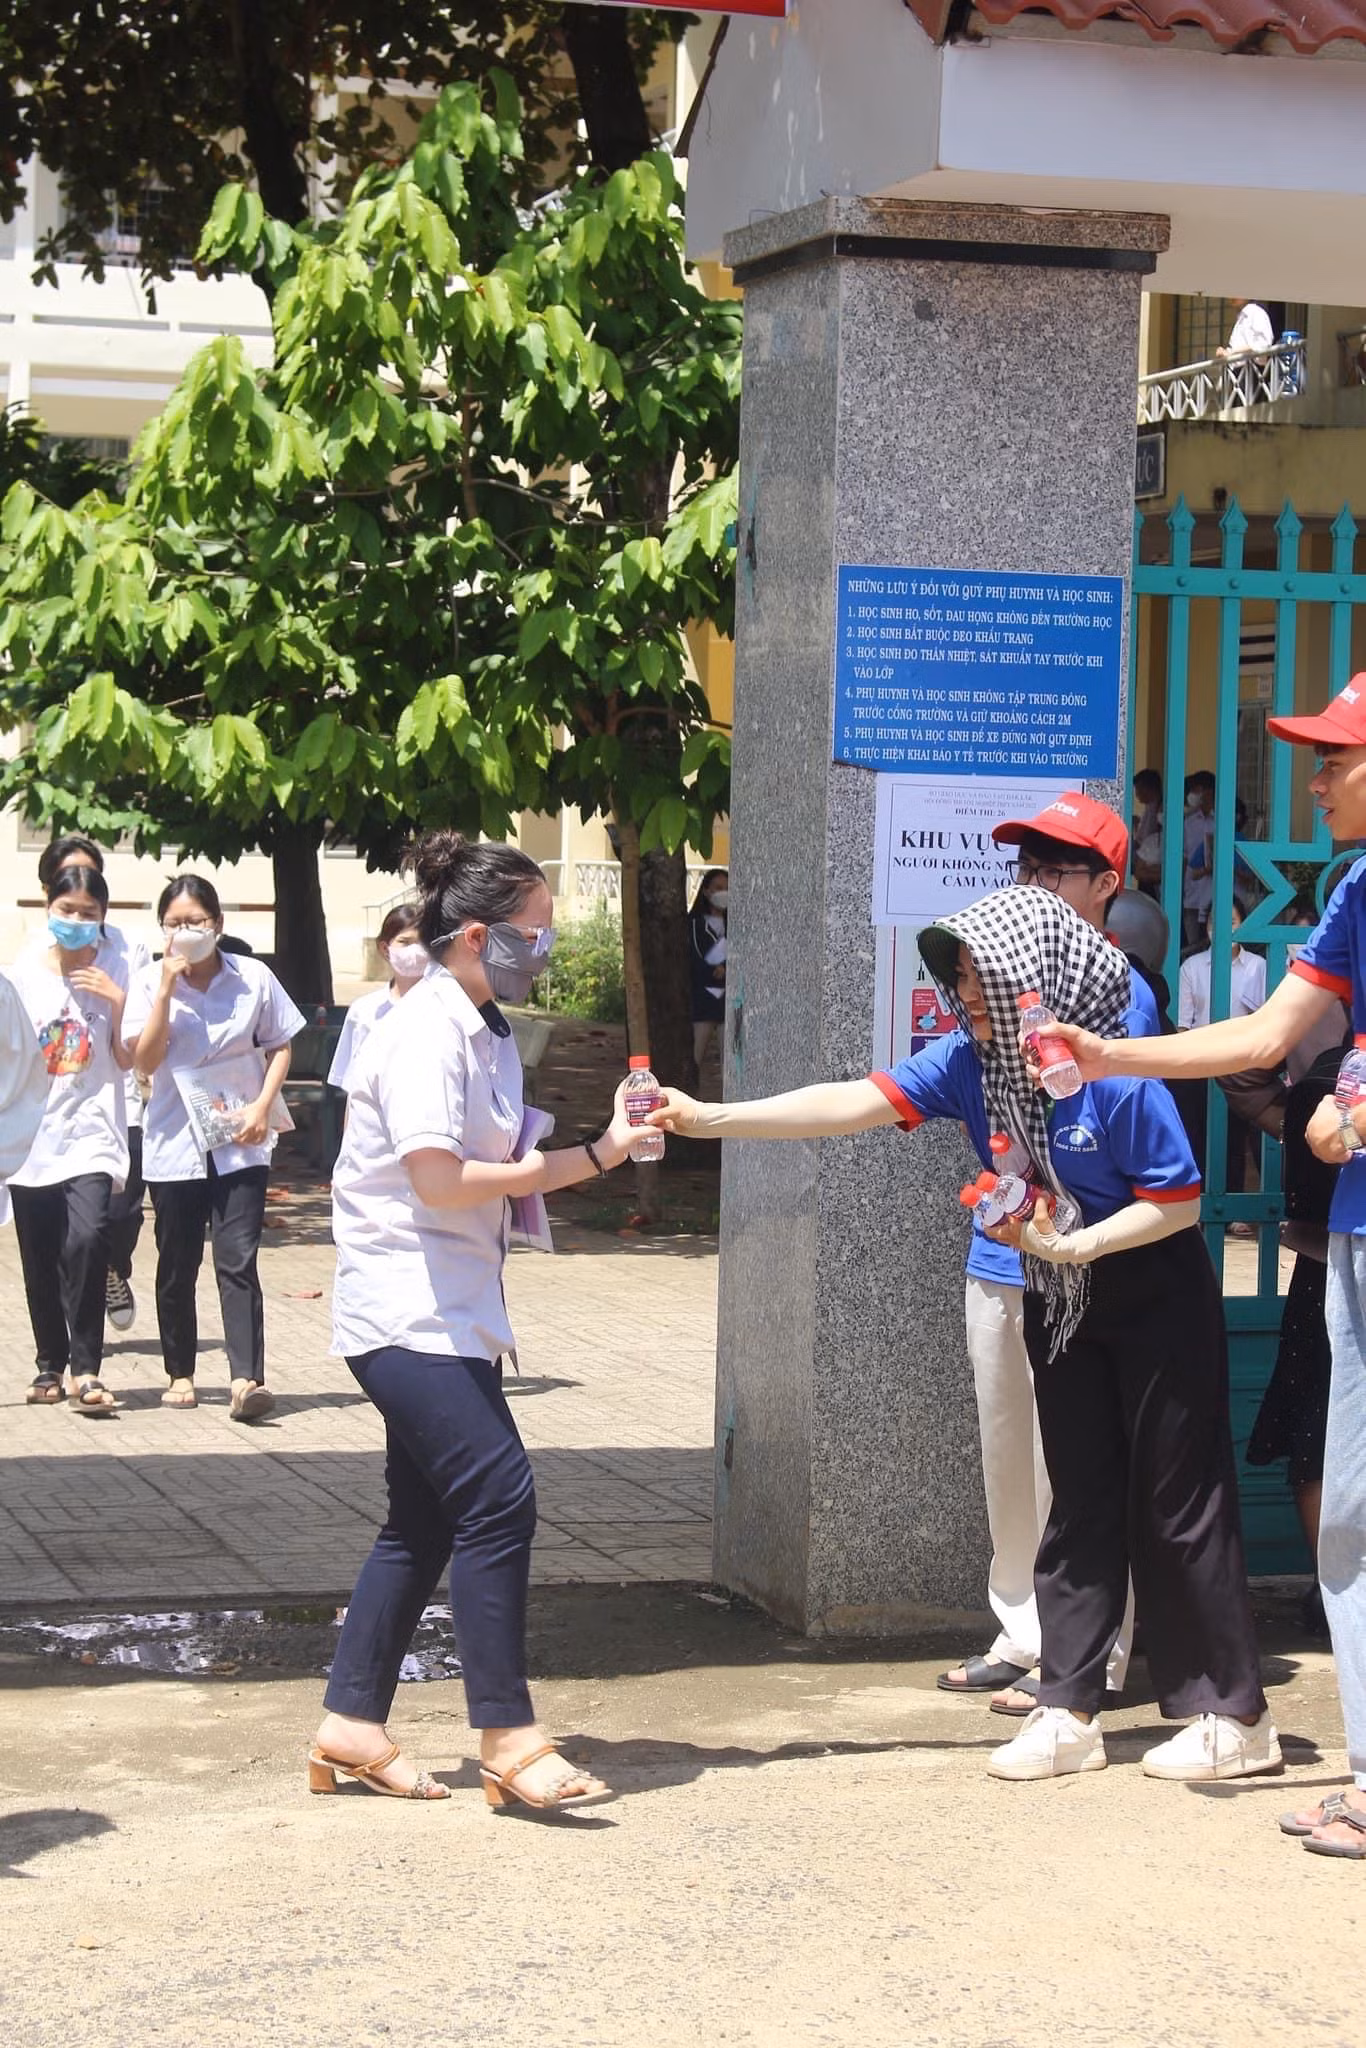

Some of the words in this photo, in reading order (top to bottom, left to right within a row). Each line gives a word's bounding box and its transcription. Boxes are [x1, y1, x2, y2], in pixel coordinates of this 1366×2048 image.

[848, 577, 884, 592] NHỮNG
[887, 580, 908, 594] LƯU
[911, 579, 918, 594] Ý
[920, 578, 938, 596] ĐỐI
[942, 580, 959, 596] VỚI
[962, 582, 983, 600] QUÝ
[986, 586, 1006, 602] PHỤ
[1009, 587, 1044, 600] HUYNH
[1047, 586, 1060, 601] VÀ
[1063, 590, 1083, 605] HỌC
[1087, 590, 1113, 603] SINH:
[848, 606, 856, 617] 1.
[858, 607, 878, 621] HỌC
[880, 608, 902, 619] SINH
[946, 610, 965, 622] ĐAU
[968, 611, 993, 626] HỌNG
[996, 610, 1028, 624] KHÔNG
[1031, 608, 1050, 625] ĐẾN
[1053, 612, 1090, 627] TRƯỜNG
[1093, 617, 1112, 631] HỌC
[846, 626, 855, 638] 2.
[858, 627, 878, 641] HỌC
[880, 628, 902, 639] SINH
[926, 627, 950, 644] BUỘC
[953, 630, 972, 642] ĐEO
[1003, 632, 1033, 645] TRANG
[846, 646, 854, 657] 3.
[857, 646, 877, 661] HỌC
[880, 648, 901, 659] SINH
[904, 648, 918, 660] ĐO
[920, 646, 945, 661] THÂN
[980, 648, 998, 663] SÁT
[1034, 653, 1051, 665] TAY
[1053, 651, 1084, 666] TRƯỚC
[1086, 656, 1103, 667] KHI
[854, 664, 873, 678] VÀO
[875, 664, 894, 679] LỚP
[845, 687, 853, 698] 4.
[856, 687, 875, 702] PHỤ
[878, 688, 909, 700] HUYNH
[912, 686, 924, 700] VÀ
[926, 690, 946, 704] HỌC
[948, 690, 970, 702] SINH
[973, 689, 1005, 704] KHÔNG
[1008, 690, 1025, 707] TẬP
[1028, 693, 1058, 705] TRUNG
[1061, 692, 1087, 706] ĐÔNG
[853, 704, 884, 719] TRƯỚC
[915, 706, 953, 721] TRƯỜNG
[956, 708, 968, 722] VÀ
[971, 708, 988, 722] GIỮ
[1031, 710, 1055, 725] CÁCH
[1058, 714, 1071, 726] 2M
[844, 727, 852, 738] 5.
[855, 728, 874, 742] PHỤ
[877, 728, 908, 740] HUYNH
[911, 726, 923, 740] VÀ
[926, 730, 944, 744] HỌC
[948, 730, 969, 742] SINH
[986, 732, 999, 743] XE
[1002, 729, 1027, 744] ĐÚNG
[1049, 734, 1067, 748] QUY
[1070, 735, 1092, 748] ĐỊNH
[855, 746, 880, 762] THỰC
[882, 746, 904, 763] HIỆN
[908, 749, 930, 760] KHAI
[932, 748, 952, 761] BÁO
[954, 751, 960, 761] Y
[963, 746, 974, 762] TẾ
[977, 749, 1008, 763] TRƯỚC
[1011, 752, 1027, 764] KHI
[1029, 750, 1048, 764] VÀO
[1051, 750, 1088, 765] TRƯỜNG
[902, 830, 952, 850] KHU
[893, 856, 937, 869] NGƯỜI
[942, 857, 991, 871] KHÔNG
[981, 874, 1012, 889] VÀO
